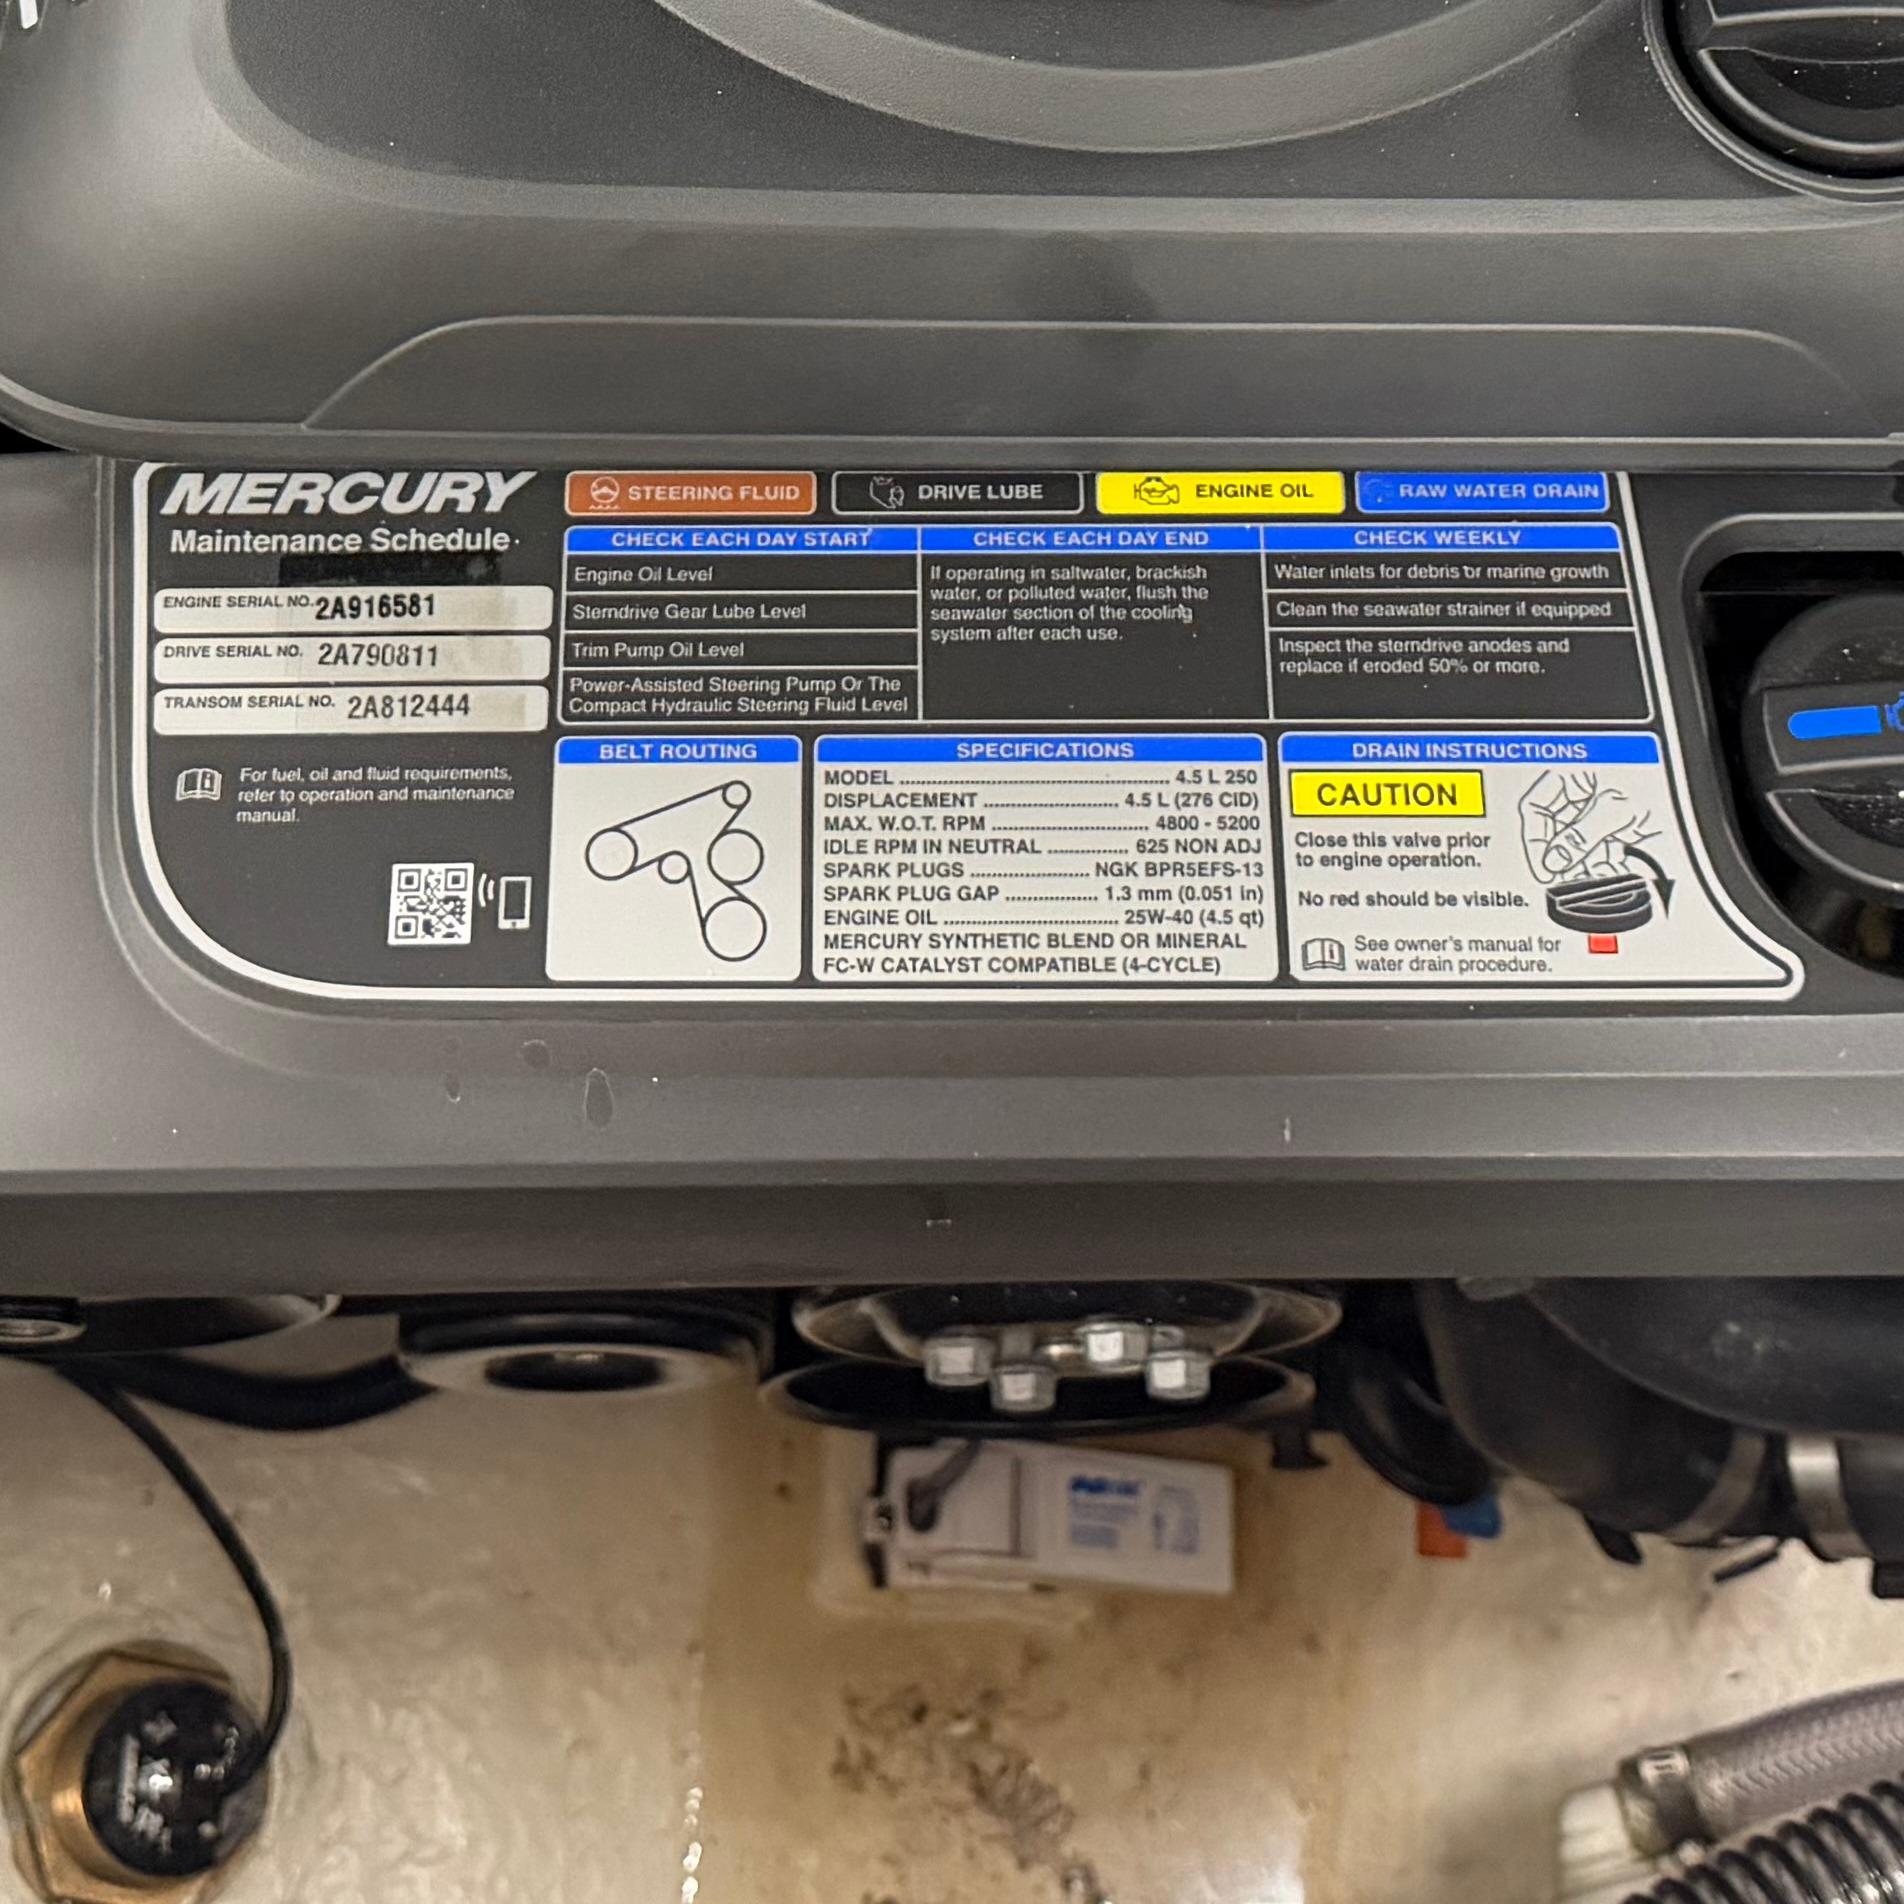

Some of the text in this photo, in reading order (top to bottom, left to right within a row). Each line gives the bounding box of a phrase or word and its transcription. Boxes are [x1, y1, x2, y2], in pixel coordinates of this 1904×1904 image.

[160, 472, 537, 515] MERCURY
[628, 486, 800, 501] STEERING FLUID
[919, 484, 1043, 500] DRIVE LUBE
[1196, 484, 1314, 498] ENGINE OIL
[1400, 484, 1599, 498] RAW WATER DRAIN
[171, 528, 510, 553] Maintenance Schedule
[612, 531, 872, 547] CHECK EACH DAY START
[974, 531, 1209, 546] CHECK EACH DAY END
[1354, 530, 1521, 545] CHECK WEEKLY
[575, 566, 713, 585] Engine Oil Level
[164, 593, 434, 620] ENGINE SERIAL NO. 2A916581
[573, 604, 806, 620] Sterndrive Gear Lube Level
[164, 643, 437, 667] DRIVE SERIAL NO. 2A790811
[572, 642, 744, 660] Trim Pump Oil Level
[1279, 638, 1570, 656] Inspect the sterndrive anodes and
[164, 694, 470, 719] TRANSOM SERIAL NO. 2A812444
[600, 744, 757, 759] BELT ROUTING
[957, 743, 1134, 758] SPECIFICATIONS
[1353, 743, 1588, 759] DRAIN INSTRUCTIONS
[825, 770, 1257, 786] MODEL 4.5 L 250
[824, 792, 1259, 811] DISPLACEMENT 4.5 L (276 CID)
[1318, 783, 1457, 806] CAUTION
[824, 816, 872, 831] MAX.
[878, 816, 936, 831] W.O.T.
[943, 816, 985, 831] RPM
[1156, 816, 1199, 831] 4800
[1218, 816, 1260, 831] 5200
[824, 838, 1261, 855] IDLE RPM IN NEUTRAL 625 NON ADJ
[1295, 832, 1491, 852] Close this valve prior
[824, 862, 890, 878] SPARK
[898, 862, 964, 878] PLUGS
[1096, 862, 1138, 877] NGK
[1296, 852, 1481, 871] to engine operation.
[824, 885, 1263, 905] SPARK PLUG GAP 1.3 mm (0.051 in)
[1299, 891, 1529, 907] No red should be visible.
[824, 909, 1264, 928] ENGINE OIL 25W-40 (4.5 qt)
[824, 933, 1247, 949] MERCURY SYNTHETIC BLEND OR MINERAL
[1355, 935, 1561, 952] See owner's manual for
[824, 957, 1221, 976] FC-W CATALYST COMPATIBLE (4-CYCLE)
[1356, 956, 1552, 974] water drain procedure.
